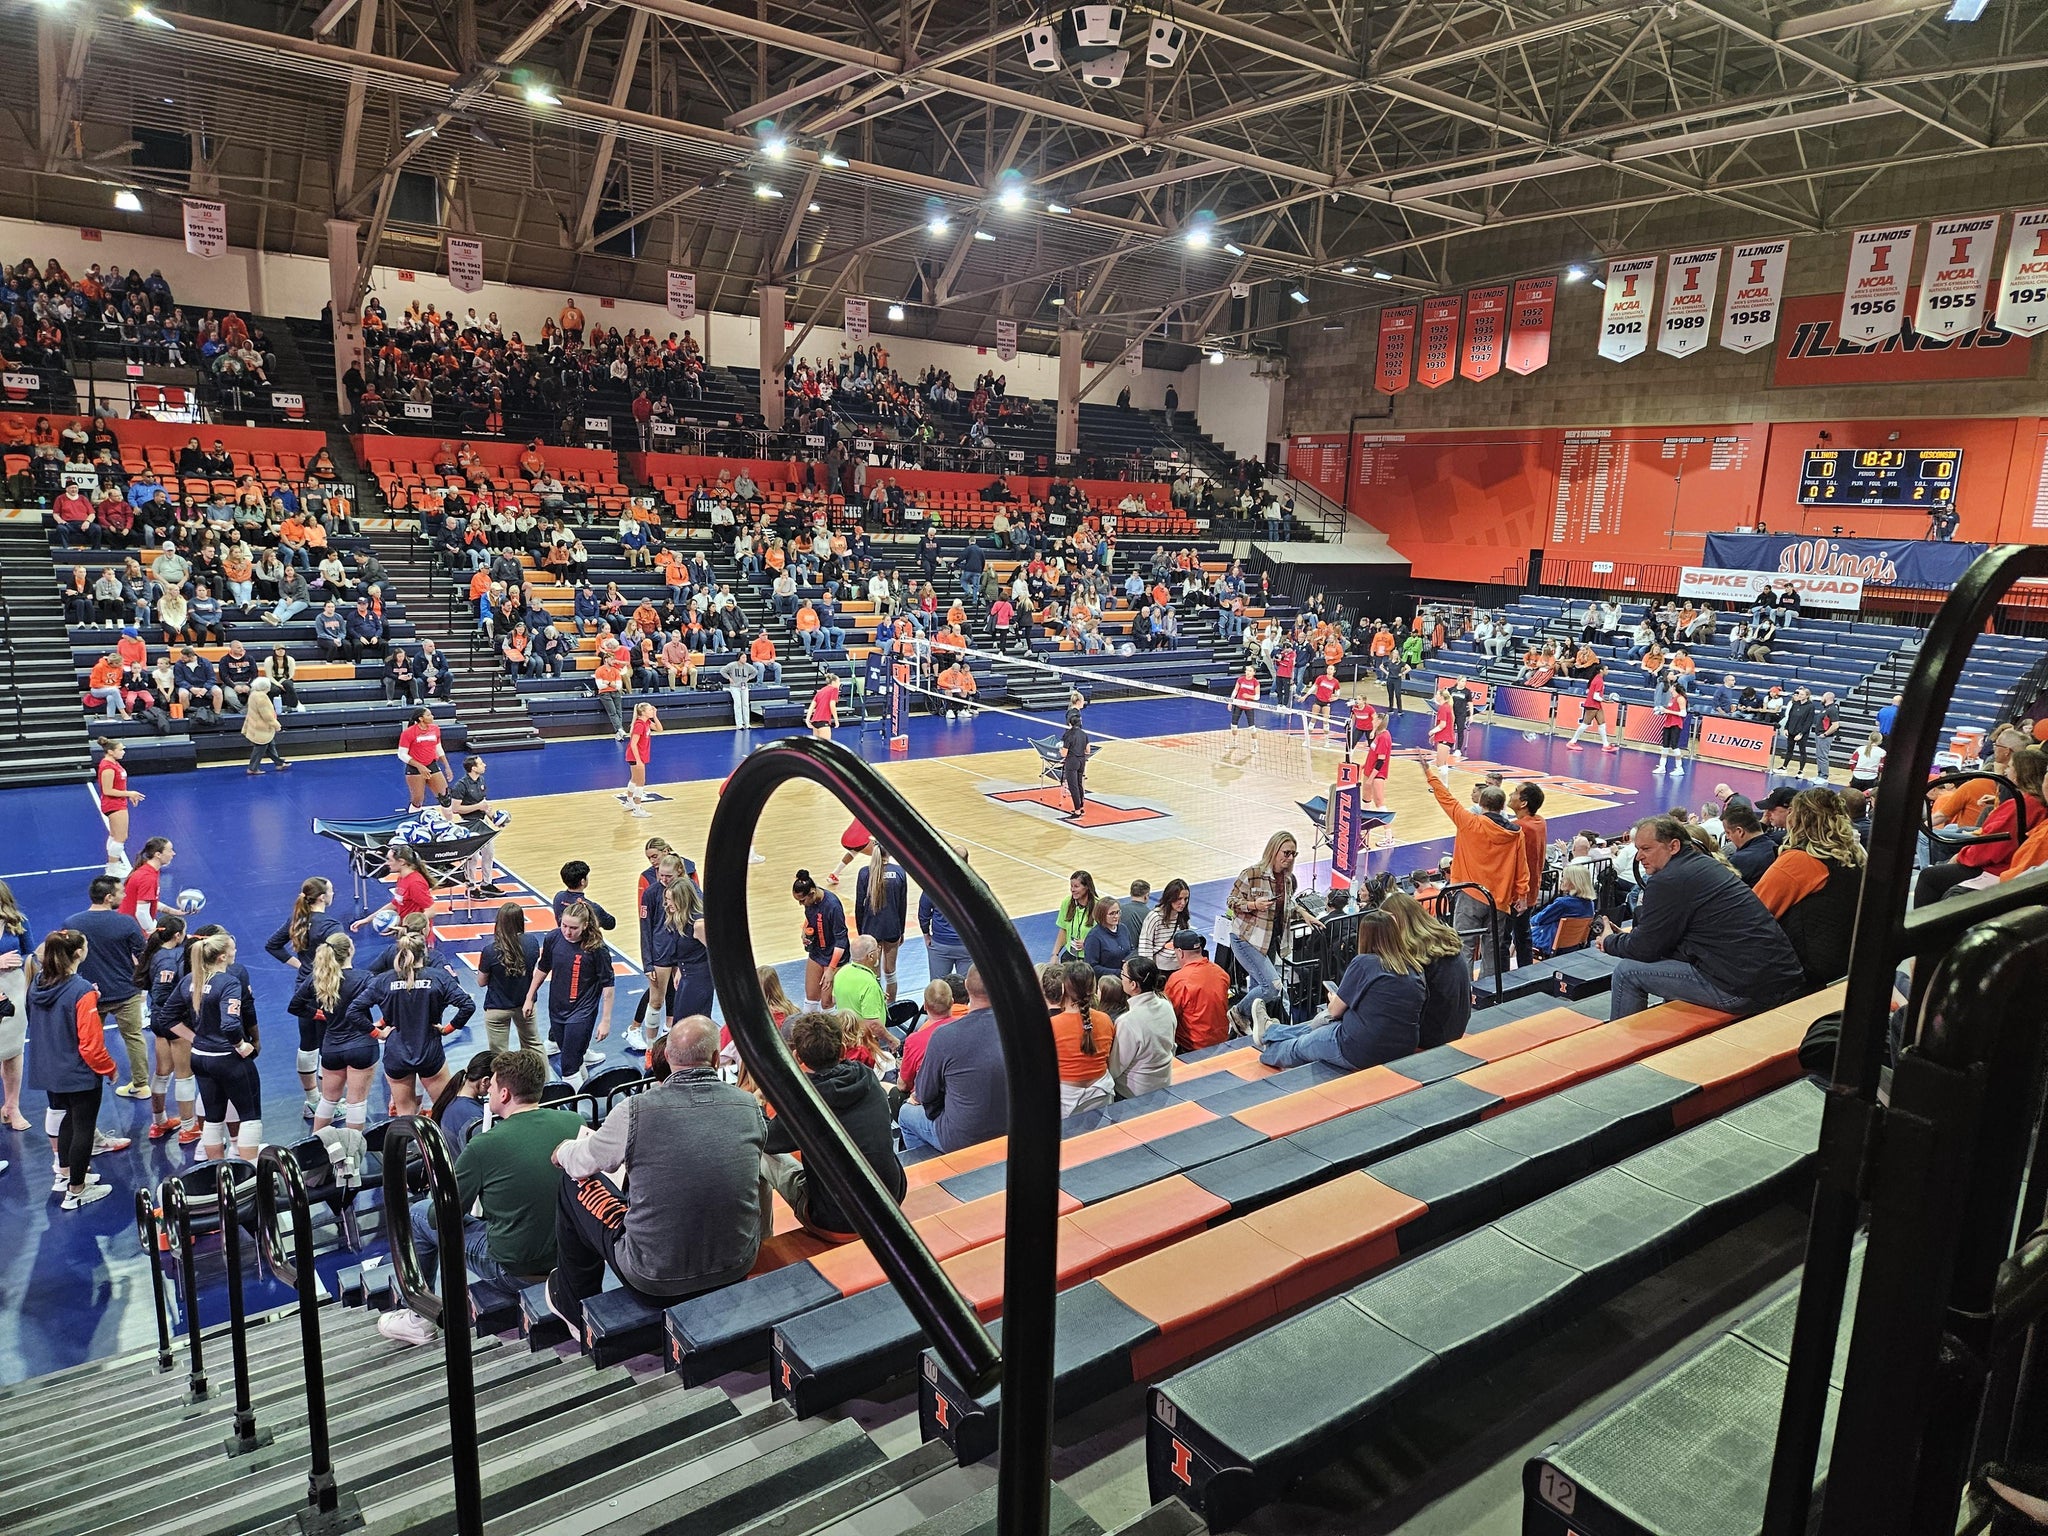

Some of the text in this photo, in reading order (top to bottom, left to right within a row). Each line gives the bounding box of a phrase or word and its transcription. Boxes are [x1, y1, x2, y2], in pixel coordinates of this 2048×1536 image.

[1936, 219, 1994, 235] ILLINOIS
[1858, 229, 1911, 244] ILLINOIS
[451, 240, 479, 249] ILLINOIS
[1737, 244, 1785, 258] ILLINOIS
[1949, 236, 1973, 264] I
[1672, 252, 1717, 266] ILLINOIS
[1870, 245, 1892, 272] I
[1612, 260, 1654, 273] ILLINOIS
[1748, 259, 1768, 284] I
[1683, 266, 1701, 291] I
[1858, 275, 1894, 289] NCAA
[1936, 268, 1975, 282] NCAA
[1519, 280, 1554, 291] ILLINOIS
[1622, 274, 1639, 297] I
[1472, 289, 1505, 300] ILLINOIS
[1672, 294, 1703, 306] NCAA
[1737, 287, 1769, 300] NCAA
[1427, 299, 1458, 309] ILLINOIS
[1613, 301, 1641, 312] NCAA
[1850, 299, 1896, 315] 1956
[1929, 293, 1977, 310] 1955
[1385, 309, 1413, 318] ILLINOIS
[1730, 310, 1771, 325] 1958
[1607, 321, 1642, 335] 2012
[1666, 316, 1705, 330] 1989
[17, 377, 37, 385] 210
[284, 396, 300, 404] 210
[406, 406, 421, 414] 211
[1810, 451, 1839, 459] ILLINOIS
[1861, 450, 1903, 466] 18:21
[1919, 451, 1957, 459] WISCONSIN
[1822, 461, 1833, 477] 0
[1937, 461, 1951, 478] 0
[1809, 486, 1818, 498] 0
[1824, 486, 1835, 498] 2
[1913, 487, 1925, 500] 2
[1940, 487, 1950, 500] 0
[1777, 538, 1897, 585] Illinois
[1683, 573, 1859, 595] SPIKE SQUAD
[1716, 591, 1757, 599] VOLLEYBAL
[1707, 733, 1764, 750] ILLINOIS
[1342, 768, 1350, 781] I
[1337, 791, 1352, 870] ILLINOIS
[434, 851, 459, 859] molten
[390, 979, 432, 991] HERNDEZ
[925, 1358, 937, 1380] 10
[935, 1391, 949, 1430] I
[1159, 1398, 1173, 1422] 11
[1171, 1437, 1192, 1487] I
[1545, 1474, 1572, 1509] 12
